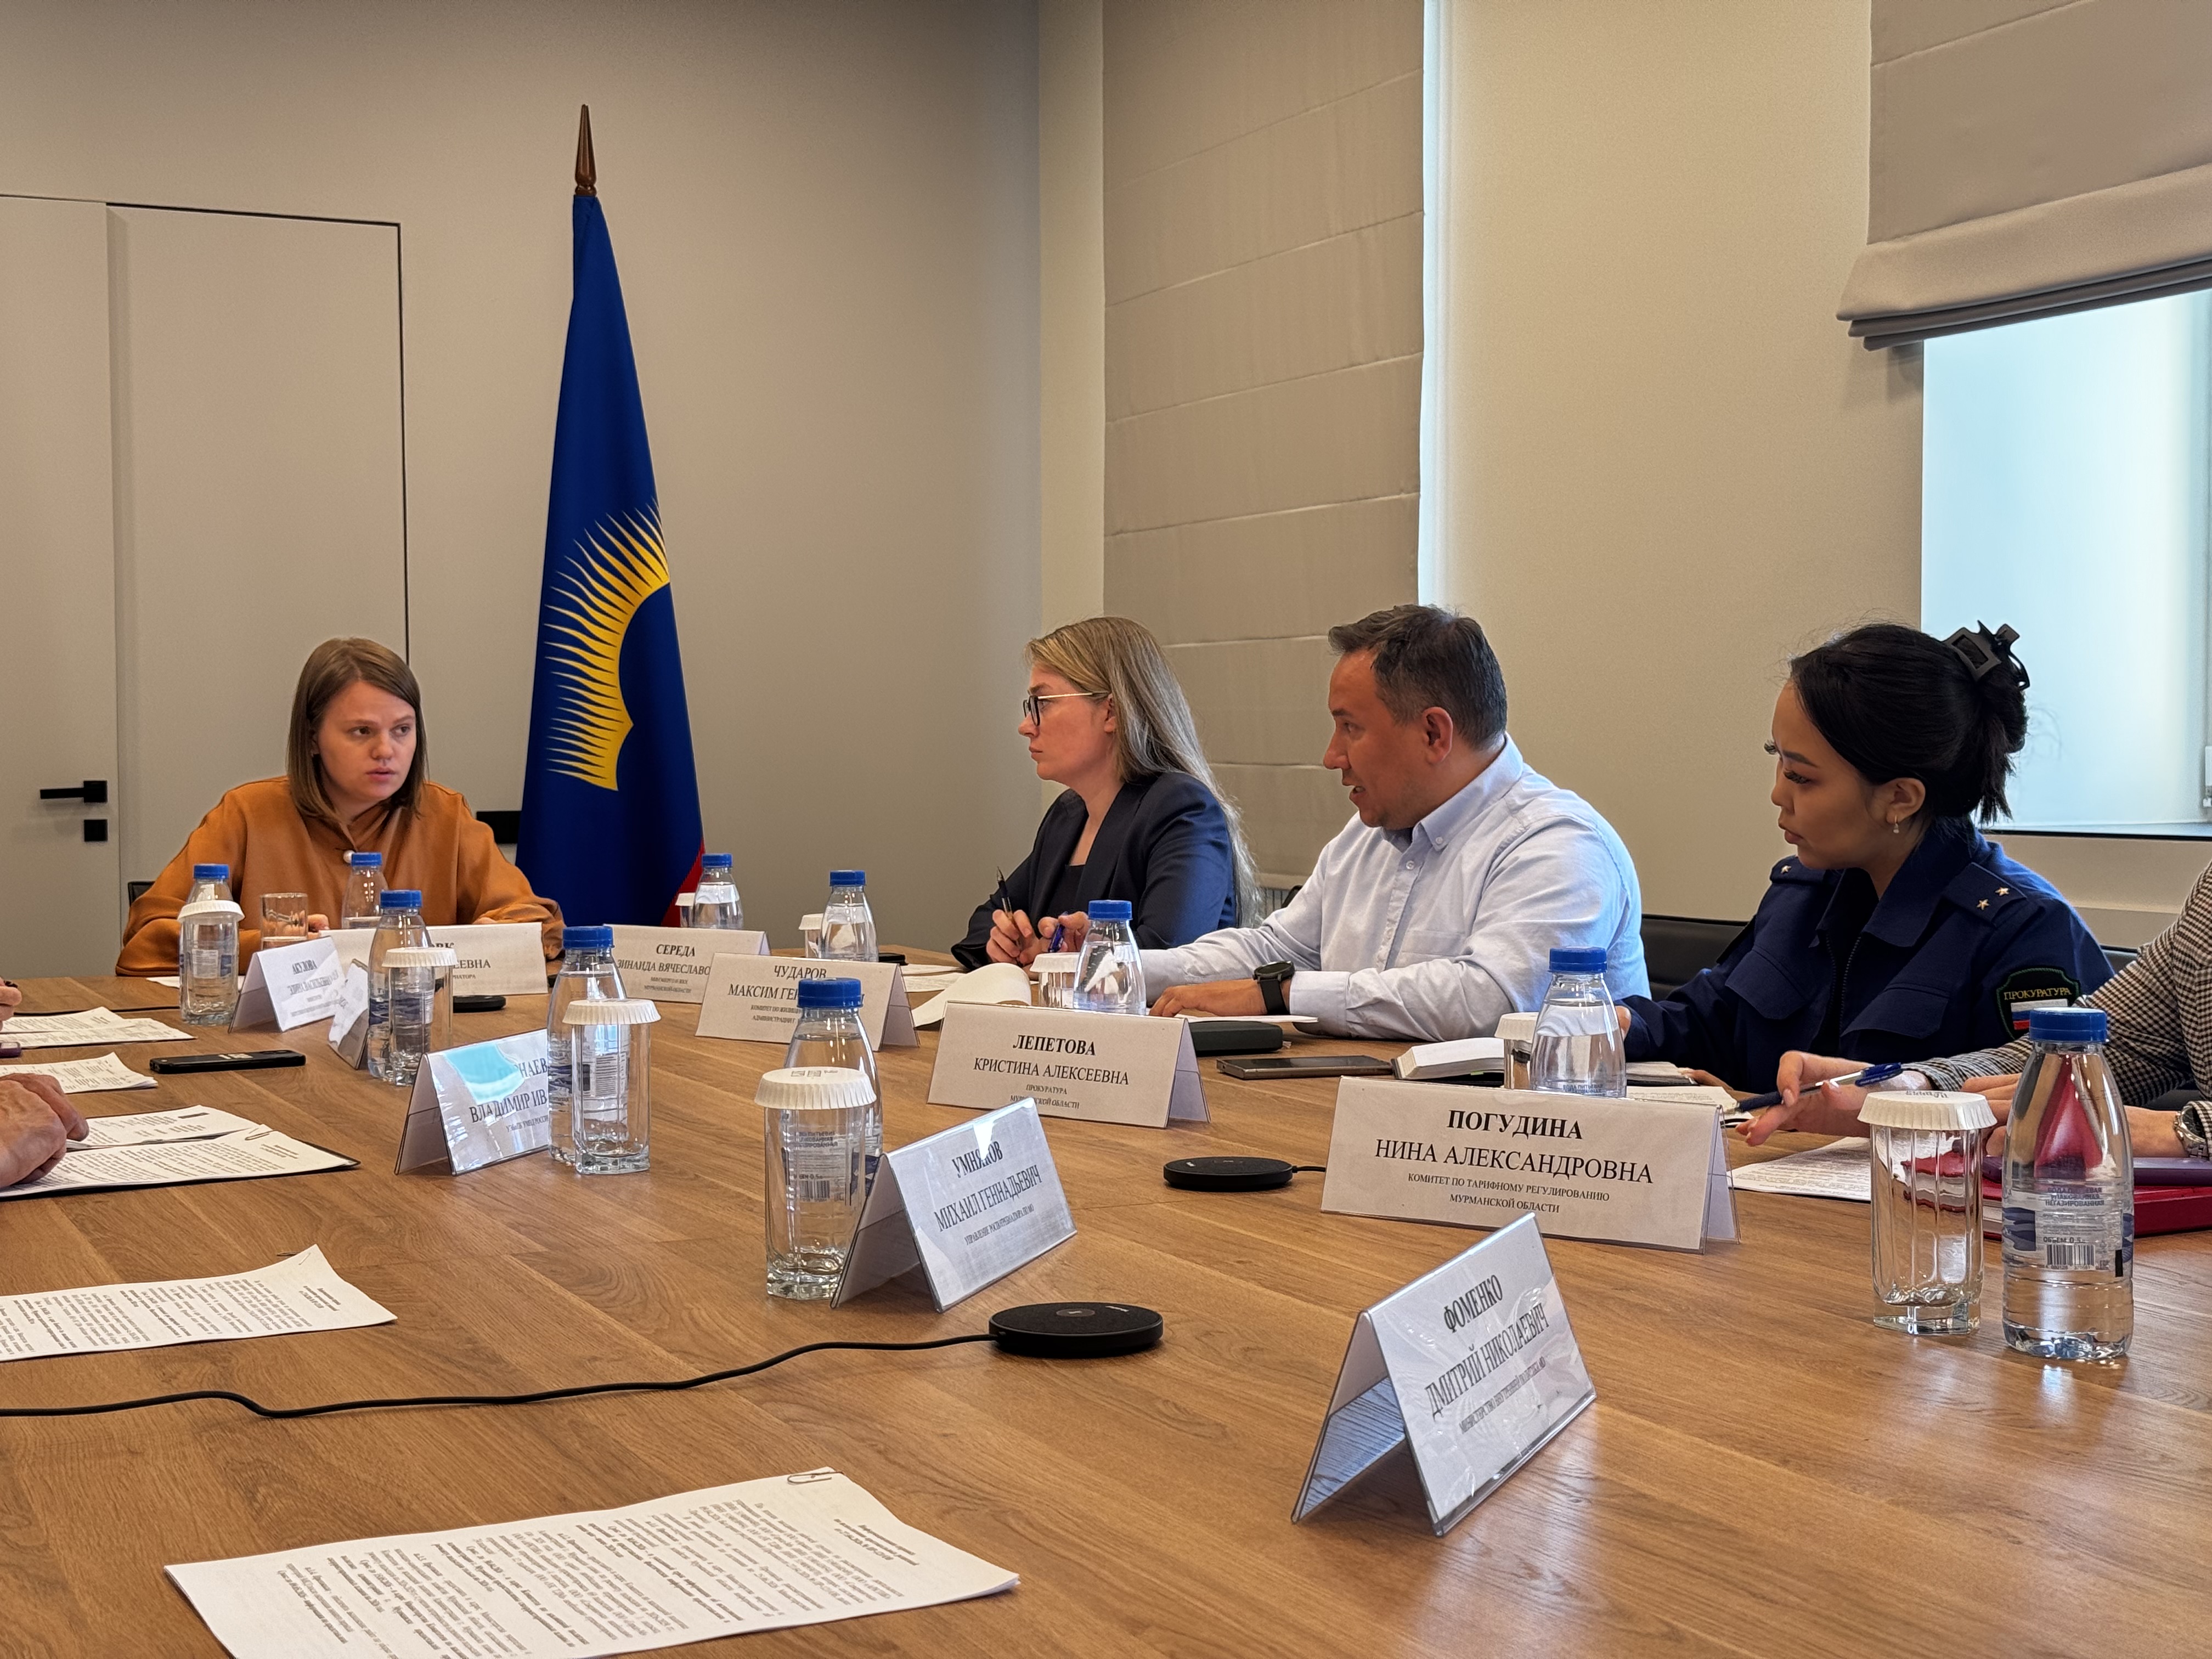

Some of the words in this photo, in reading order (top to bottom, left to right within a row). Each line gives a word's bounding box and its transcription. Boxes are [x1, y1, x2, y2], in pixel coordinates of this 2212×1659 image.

[656, 944, 695, 957] СЕРЕДА
[292, 960, 318, 975] АКУЛОВА
[618, 960, 657, 972] ЗИНАИДА
[658, 962, 710, 975] ВЯЧЕСЛАВО
[774, 966, 827, 980] ЧУДАРОВ
[728, 984, 778, 999] МАКСИМ
[2004, 987, 2072, 1000] ПРОКУРАТУРА
[1013, 1035, 1096, 1056] ЛЕПЕТОВА
[973, 1058, 1040, 1076] КРИСТИНА
[1042, 1064, 1129, 1085] АЛЕКСЕЕВНА
[1026, 1084, 1067, 1094] ПРОКУРАТУРА
[469, 1093, 530, 1123] ВЛАДИМИР
[1052, 1099, 1079, 1109] ОБЛАСТИ
[1446, 1110, 1583, 1141] ПОГУДИНА
[1375, 1139, 1438, 1162] НИНА
[1443, 1146, 1654, 1184] АЛЕКСАНДРОВНА
[1408, 1173, 1451, 1184] КОМИТЕТ
[1452, 1177, 1465, 1186] ПО
[1467, 1179, 1524, 1193] ТАРИФНОМУ
[1526, 1186, 1610, 1201] РЕГУЛИРОВАНИЮ
[934, 1193, 981, 1232] МИХАИЛ
[978, 1164, 1042, 1213] ГЕННАДЬЕВИЧ
[1449, 1194, 1515, 1208] МУРМАНСКОЙ
[1517, 1201, 1560, 1213] ОБЛАСТИ
[1443, 1274, 1503, 1333] ФОМЕНКО
[1425, 1343, 1485, 1422] ДМИТРИЙ
[1480, 1302, 1550, 1375] НИКОЛАЕВИЧ
